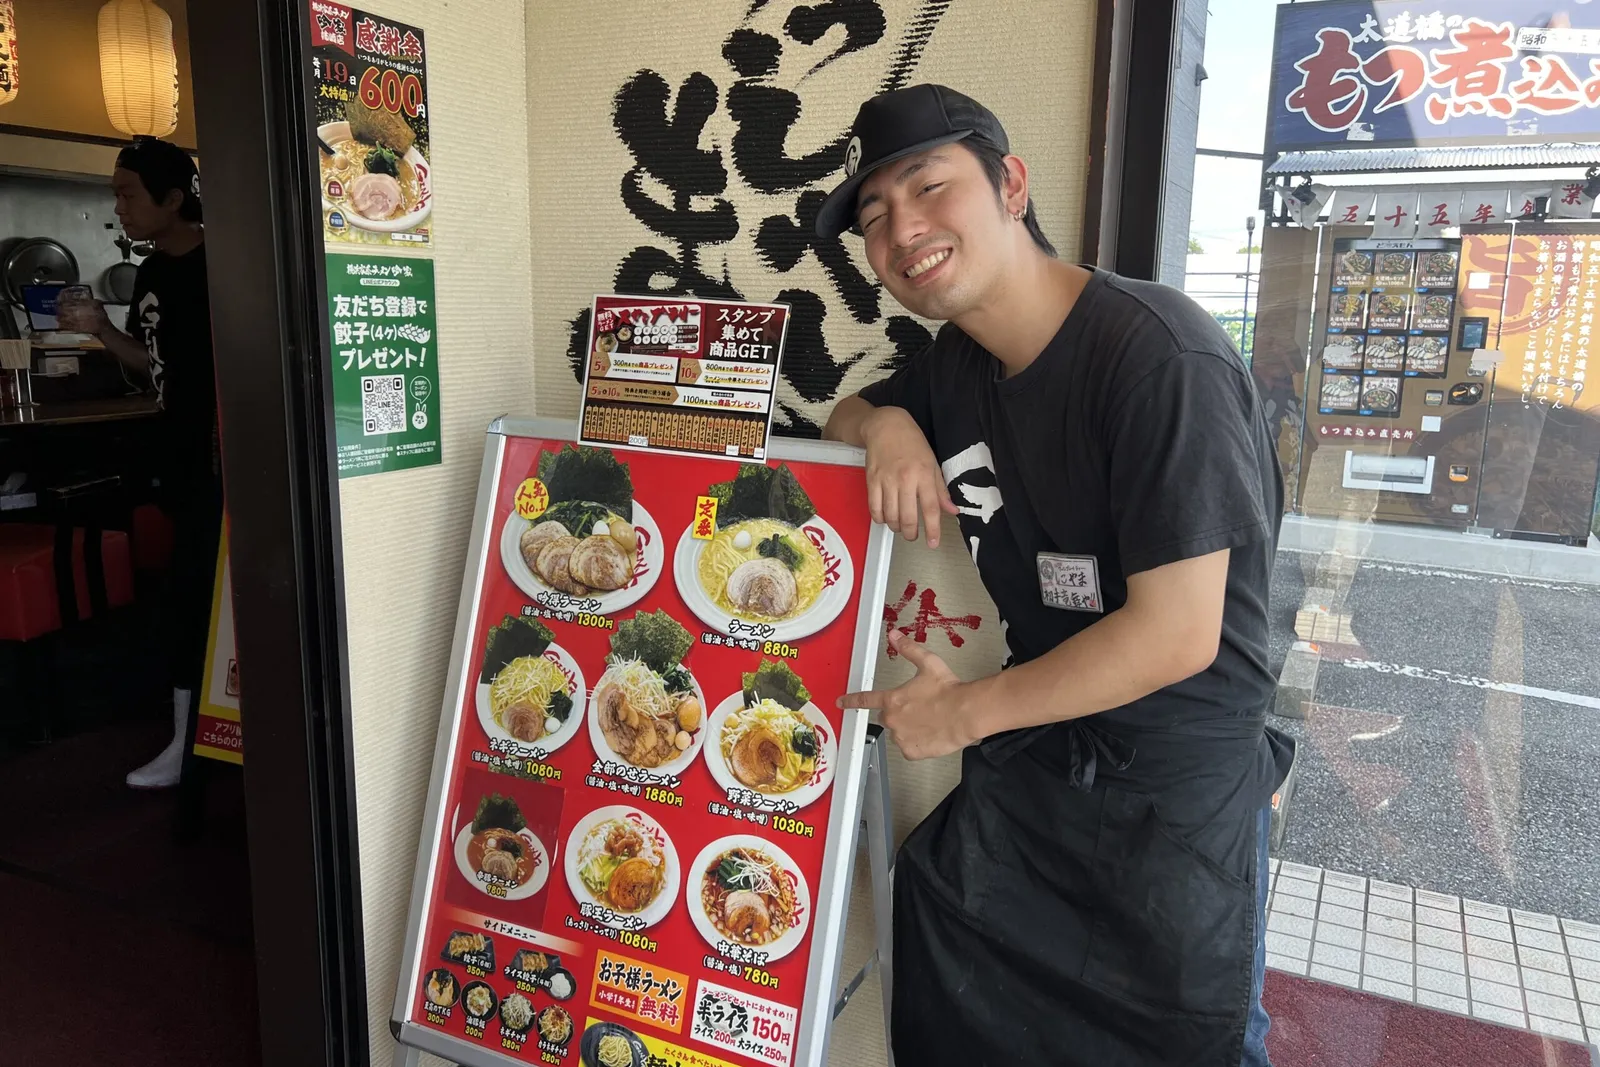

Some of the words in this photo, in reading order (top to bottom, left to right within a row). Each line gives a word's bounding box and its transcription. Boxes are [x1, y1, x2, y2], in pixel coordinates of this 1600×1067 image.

[355, 17, 423, 63] 感謝祭
[358, 66, 426, 118] 600円
[333, 294, 428, 318] 友だち登録で
[716, 308, 776, 325] スタンプ
[721, 325, 763, 342] 集めて
[340, 347, 427, 372] プレゼント!
[709, 341, 773, 360] 商品GET
[682, 395, 763, 410] 1100円までの商品プレゼント
[1320, 426, 1414, 439] もつ煮込み直売所
[517, 482, 547, 500] 人気
[518, 502, 546, 515] No.1
[695, 499, 715, 536] 定番
[577, 612, 614, 629] 1300円
[729, 619, 775, 638] ラーメン
[763, 641, 798, 658] 880円
[490, 737, 549, 760] ネギラーメン
[526, 761, 562, 780] 1080円
[591, 760, 682, 789] 全部のせラーメン
[645, 786, 683, 807] 1880円
[727, 787, 800, 815] 野菜ラーメン
[772, 815, 815, 837] 1030円
[484, 919, 537, 940] サイドメニュー
[619, 930, 657, 952] 1080円
[717, 940, 769, 967] 中華そば
[466, 965, 486, 978] 350円
[599, 957, 682, 1002] お子様ラーメン
[744, 967, 779, 989] 780円
[516, 981, 536, 994] 350円
[426, 1013, 445, 1026] 300円
[639, 995, 679, 1026] 無料
[465, 1025, 483, 1039] 300円
[697, 1000, 748, 1033] 半ライス
[752, 1016, 791, 1046] 150円
[694, 1024, 713, 1039] ライス
[714, 1030, 736, 1047] 200円
[737, 1037, 764, 1055] 大ライス
[764, 1046, 787, 1063] 250円
